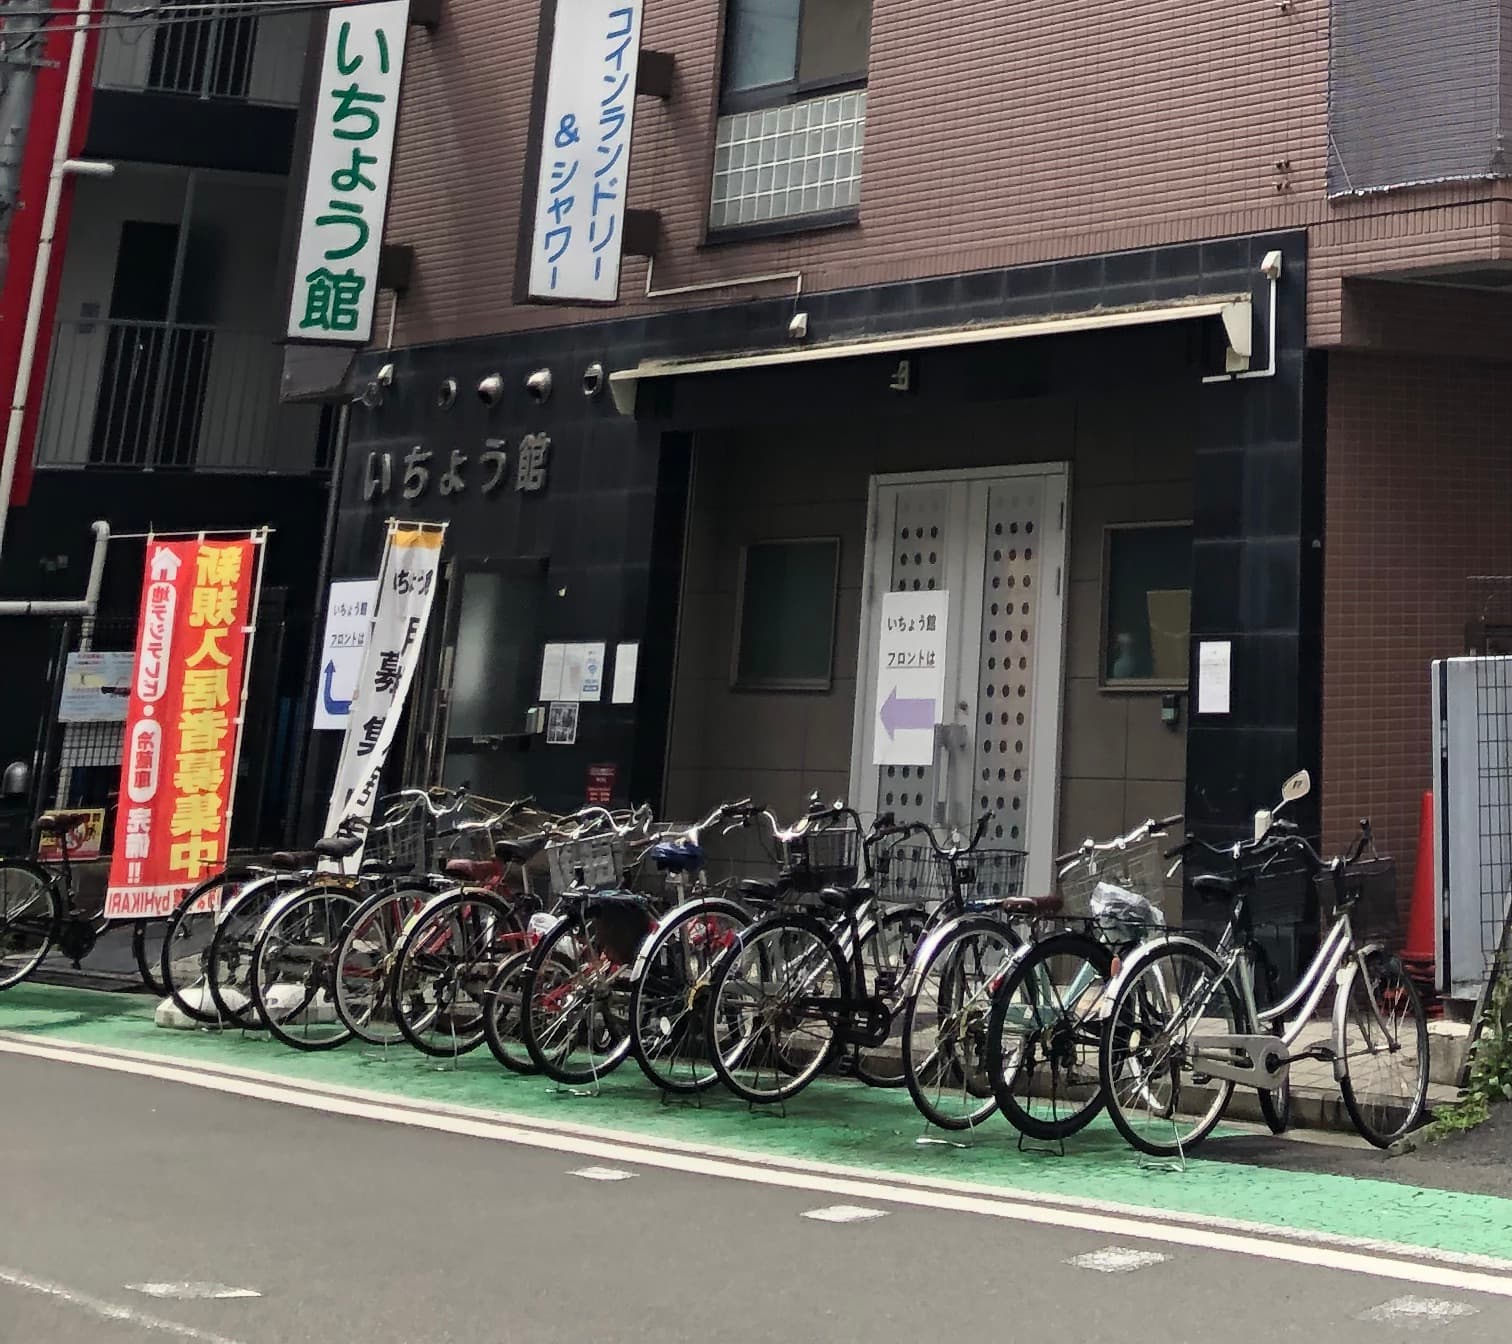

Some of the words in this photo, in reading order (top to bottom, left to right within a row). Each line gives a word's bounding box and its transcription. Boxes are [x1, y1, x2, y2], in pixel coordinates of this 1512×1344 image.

[299, 21, 390, 332] いちょう館
[589, 7, 634, 280] コインランドリー
[364, 432, 551, 501] いちょう館
[887, 614, 937, 632] いちょう館
[887, 649, 936, 666] フロントは
